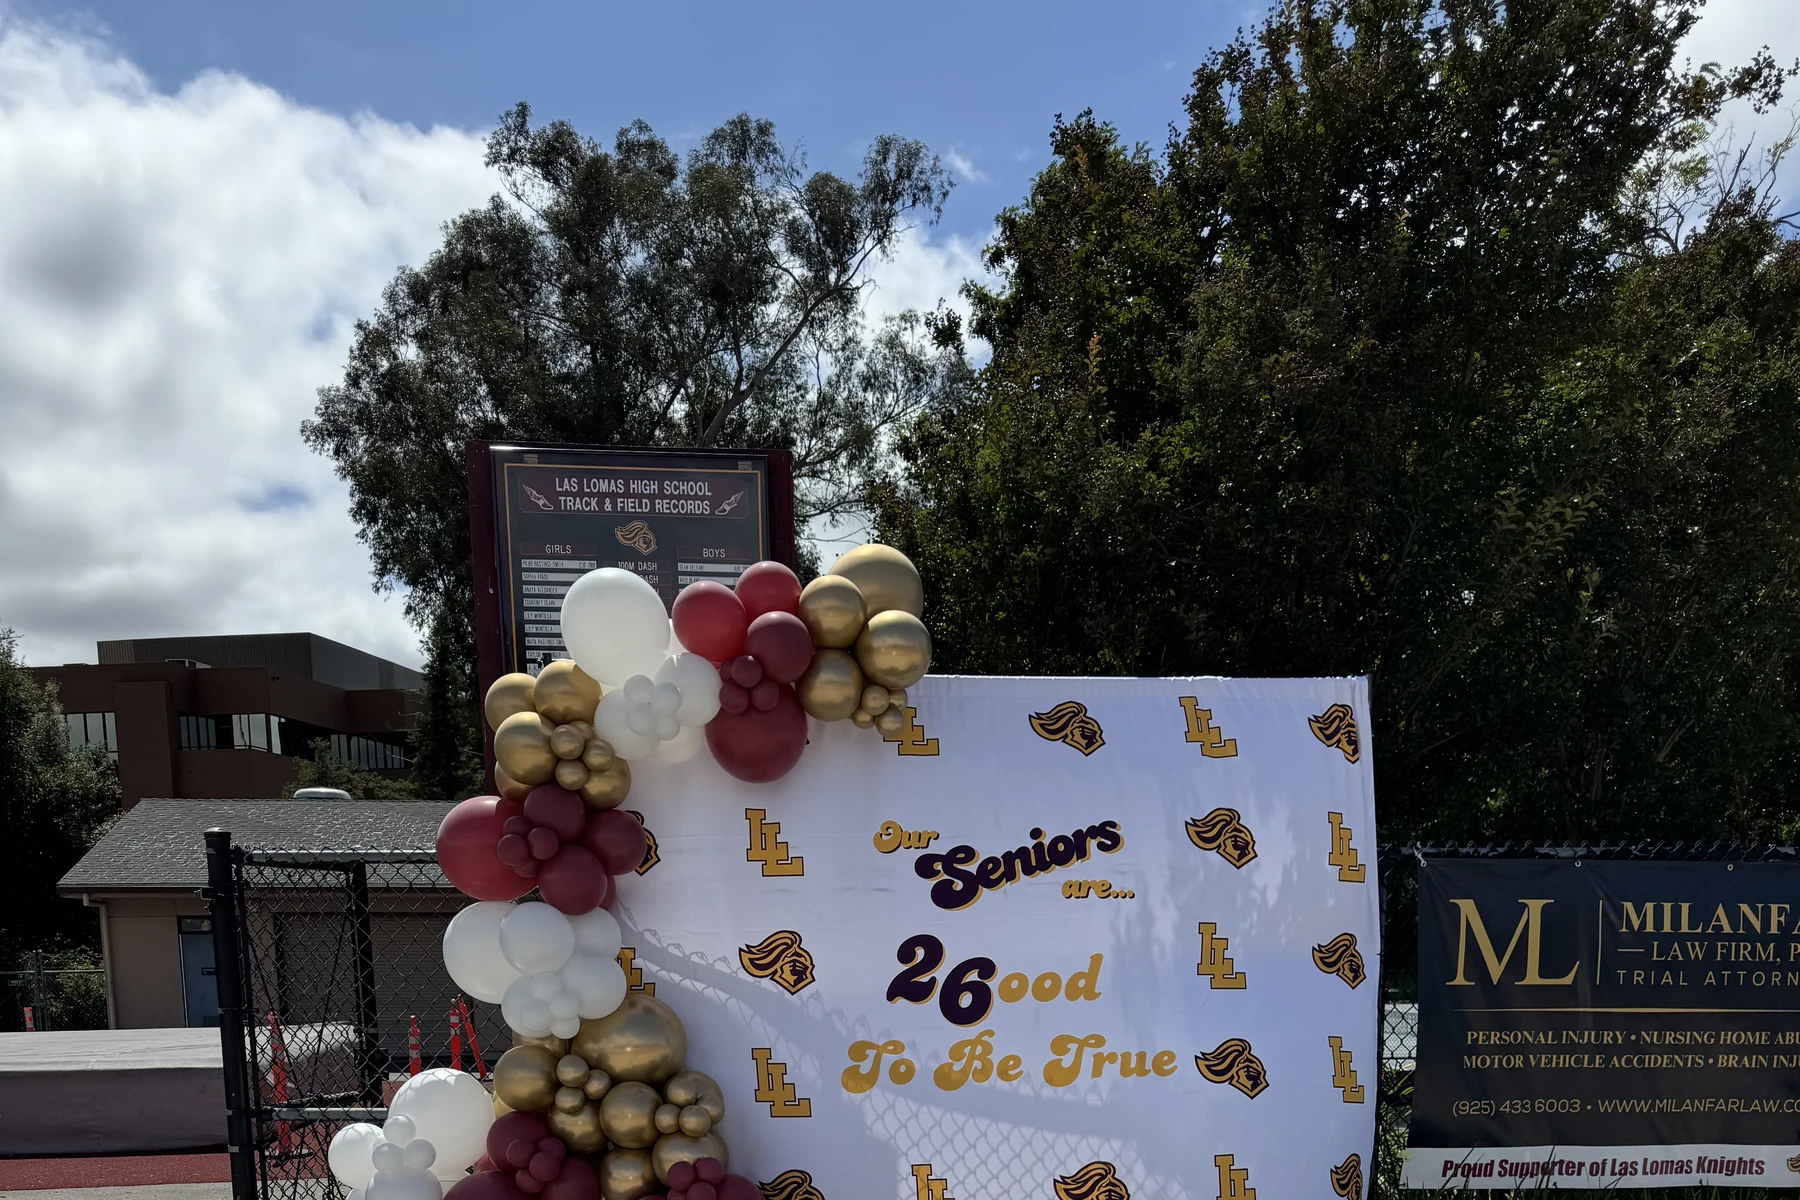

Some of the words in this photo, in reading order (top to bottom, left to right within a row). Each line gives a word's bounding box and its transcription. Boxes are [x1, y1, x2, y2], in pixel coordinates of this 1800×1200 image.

[555, 477, 578, 492] LAS
[583, 478, 625, 494] LOMAS
[629, 480, 659, 494] HIGH
[663, 481, 712, 496] SCHOOL
[558, 496, 599, 511] TRACK
[604, 498, 612, 512] &
[617, 498, 651, 513] FIELD
[655, 499, 711, 515] RECORDS
[545, 544, 572, 554] GIRLS
[702, 548, 726, 558] BOYS
[617, 561, 635, 571] 100M
[637, 561, 658, 571] DASH
[1178, 696, 1238, 758] LL
[745, 808, 804, 877] LL
[872, 820, 940, 853] Our
[1327, 811, 1366, 883] LL
[914, 820, 1125, 912] Seniors
[1061, 878, 1136, 899] are...
[1446, 899, 1580, 985] ML
[1651, 941, 1708, 961] LAW
[1716, 941, 1782, 966] FIRM,
[1197, 922, 1247, 989] LL
[1617, 970, 1688, 985] TRIAL
[1704, 971, 1800, 986] ATTORN
[1466, 1030, 1558, 1045] PERSONAL
[1561, 1030, 1626, 1044] INJURY
[1640, 1031, 1715, 1045] NURSING
[1719, 1031, 1771, 1045] HOME
[840, 1039, 916, 1094] To
[933, 1029, 1024, 1092] Be
[1042, 1033, 1178, 1088] True
[1328, 1036, 1365, 1104] LL
[1463, 1054, 1524, 1069] MOTOR
[1529, 1054, 1605, 1068] VEHICLE
[1609, 1054, 1704, 1068] ACCIDENTS
[1717, 1054, 1769, 1068] BRAIN
[1772, 1054, 1800, 1068] INJ
[751, 1047, 812, 1118] LL
[1452, 1100, 1496, 1117] (925)
[1442, 1159, 1495, 1178] Proud
[1498, 1159, 1586, 1179] Supporter
[1589, 1159, 1607, 1177] of
[1610, 1158, 1638, 1176] Las
[1642, 1157, 1693, 1176] Lomas
[1696, 1155, 1765, 1176] Knights
